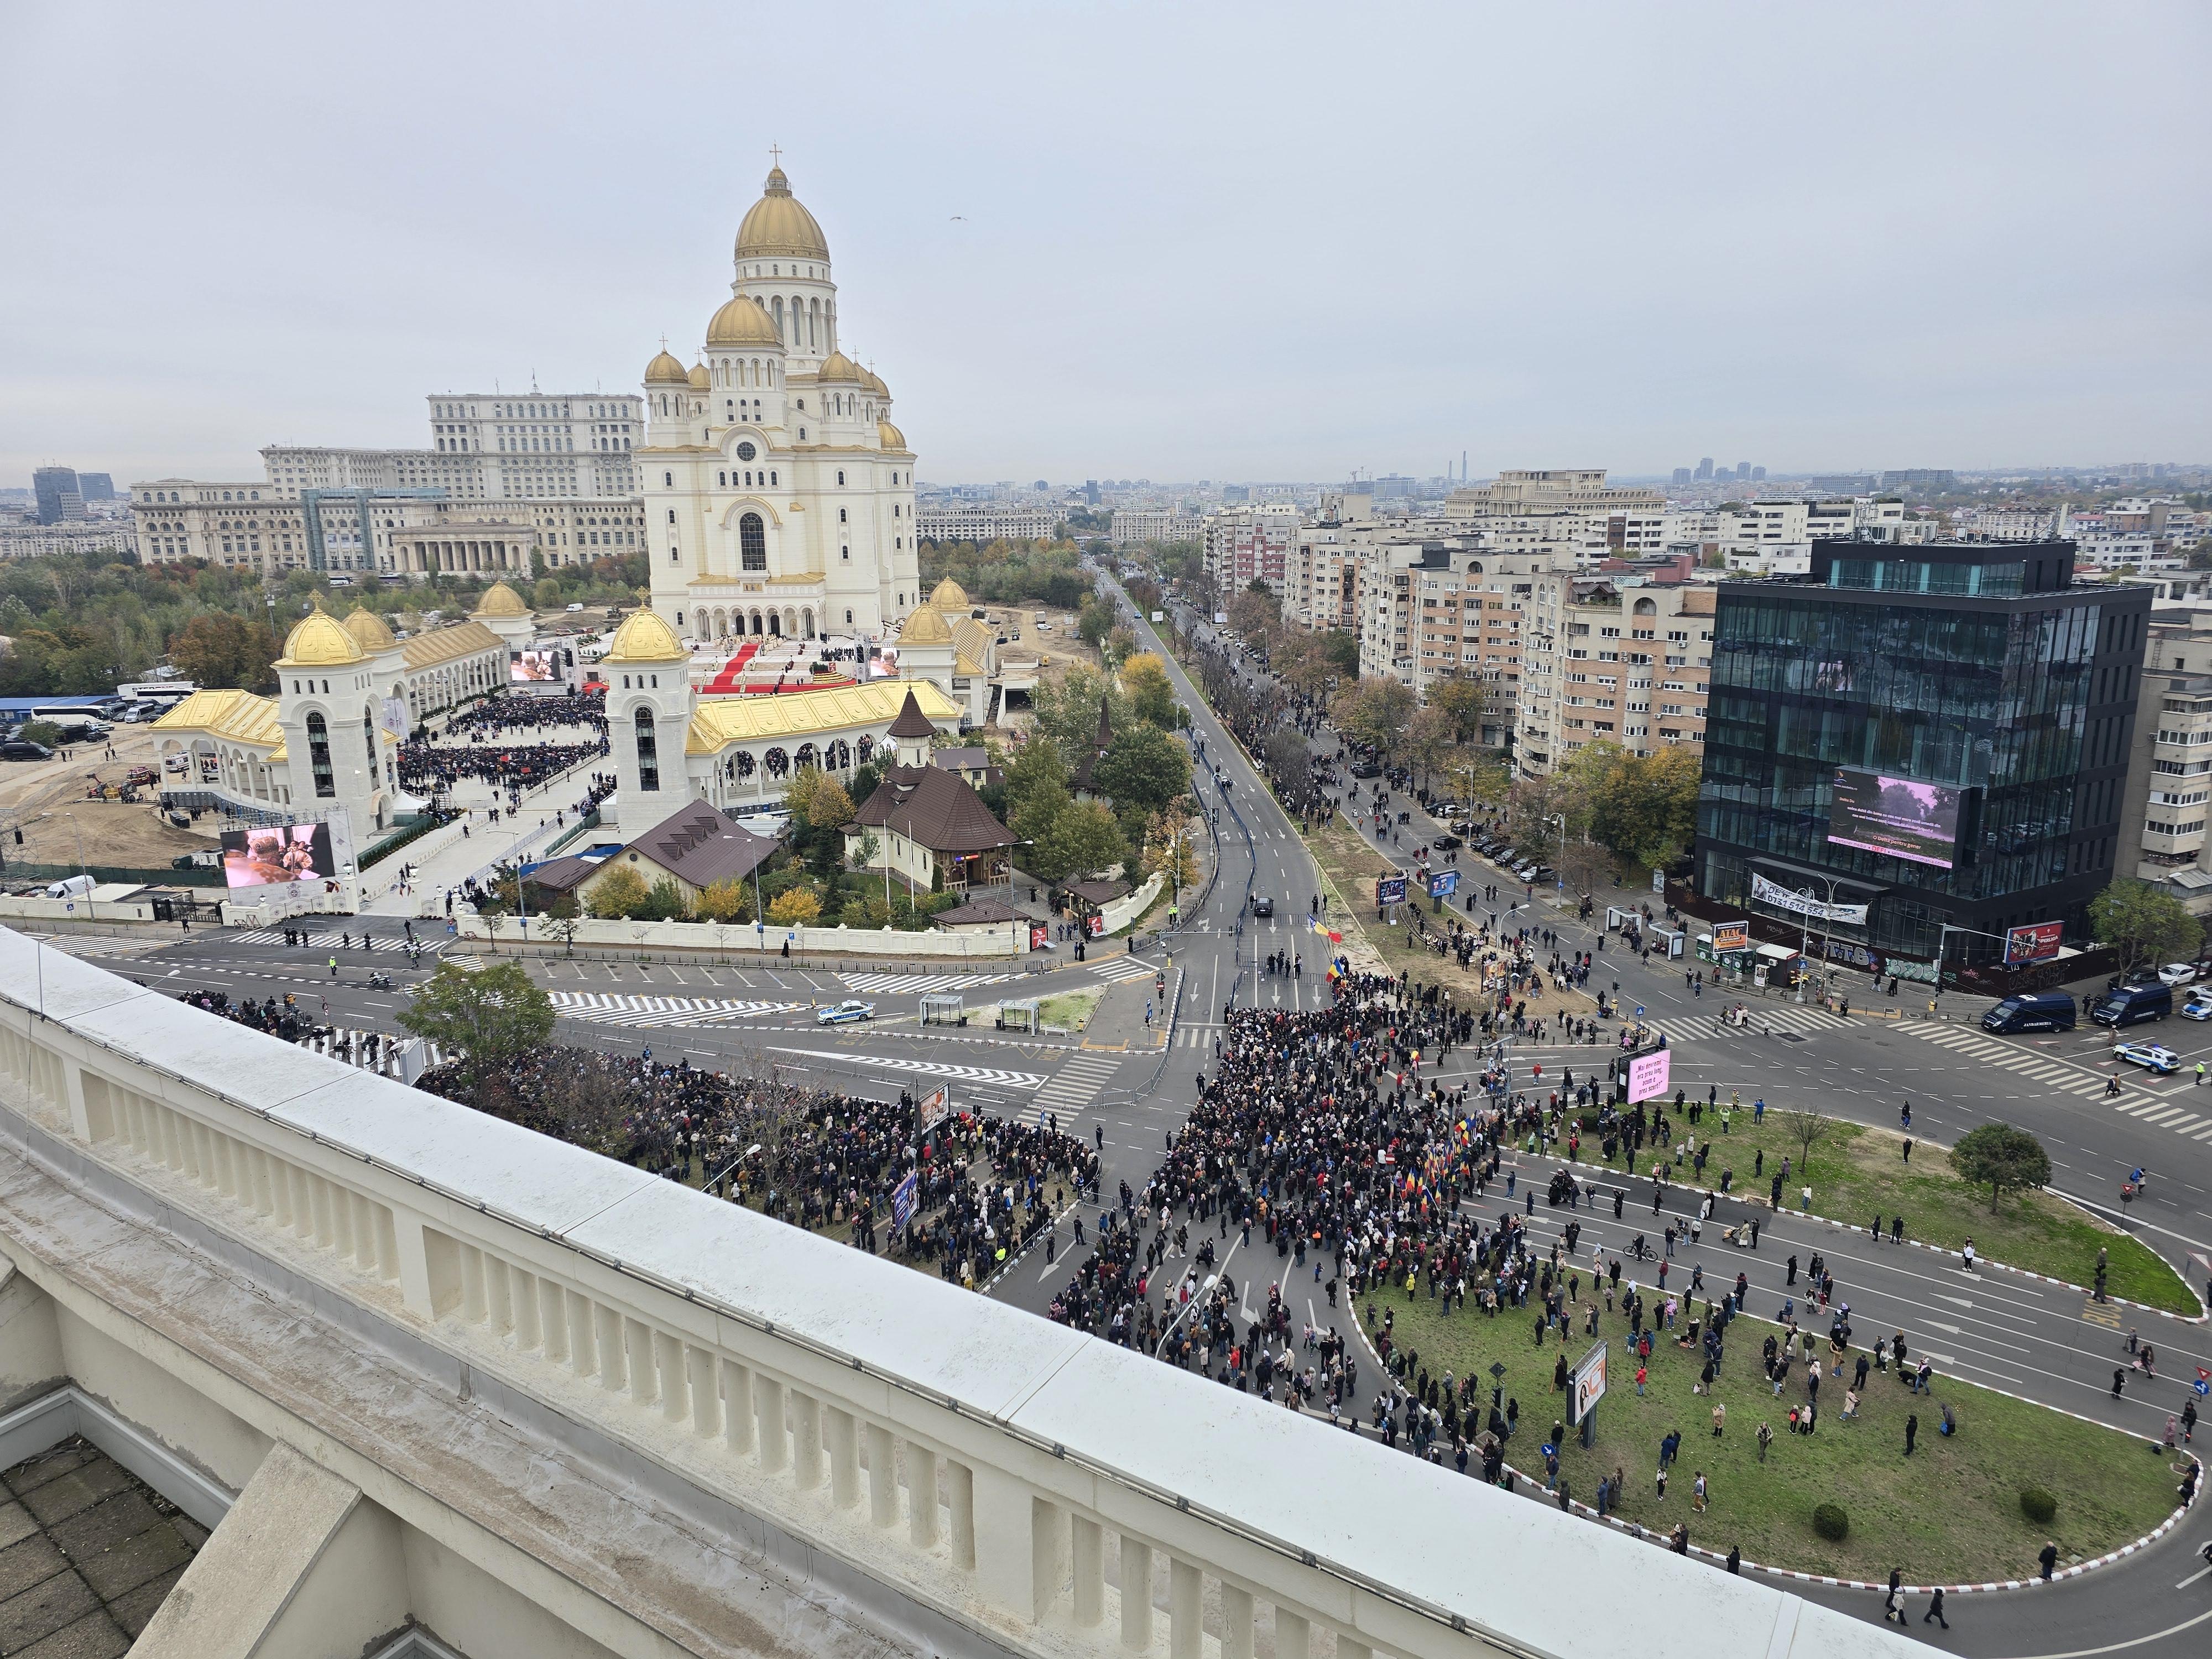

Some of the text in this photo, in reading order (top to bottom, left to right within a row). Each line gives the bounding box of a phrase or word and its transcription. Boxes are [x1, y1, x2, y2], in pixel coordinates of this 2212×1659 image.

[1836, 837, 1853, 846] Partener
[1767, 895, 1787, 907] 0731
[1788, 901, 1805, 912] 514
[1807, 906, 1824, 916] 554
[1720, 927, 1743, 938] ATAC
[1037, 1048, 1065, 1062] BUS
[1646, 1060, 1662, 1070] devreme
[1645, 1070, 1653, 1078] prea
[1639, 1087, 1647, 1096] prea
[2081, 1298, 2124, 1328] BUS
